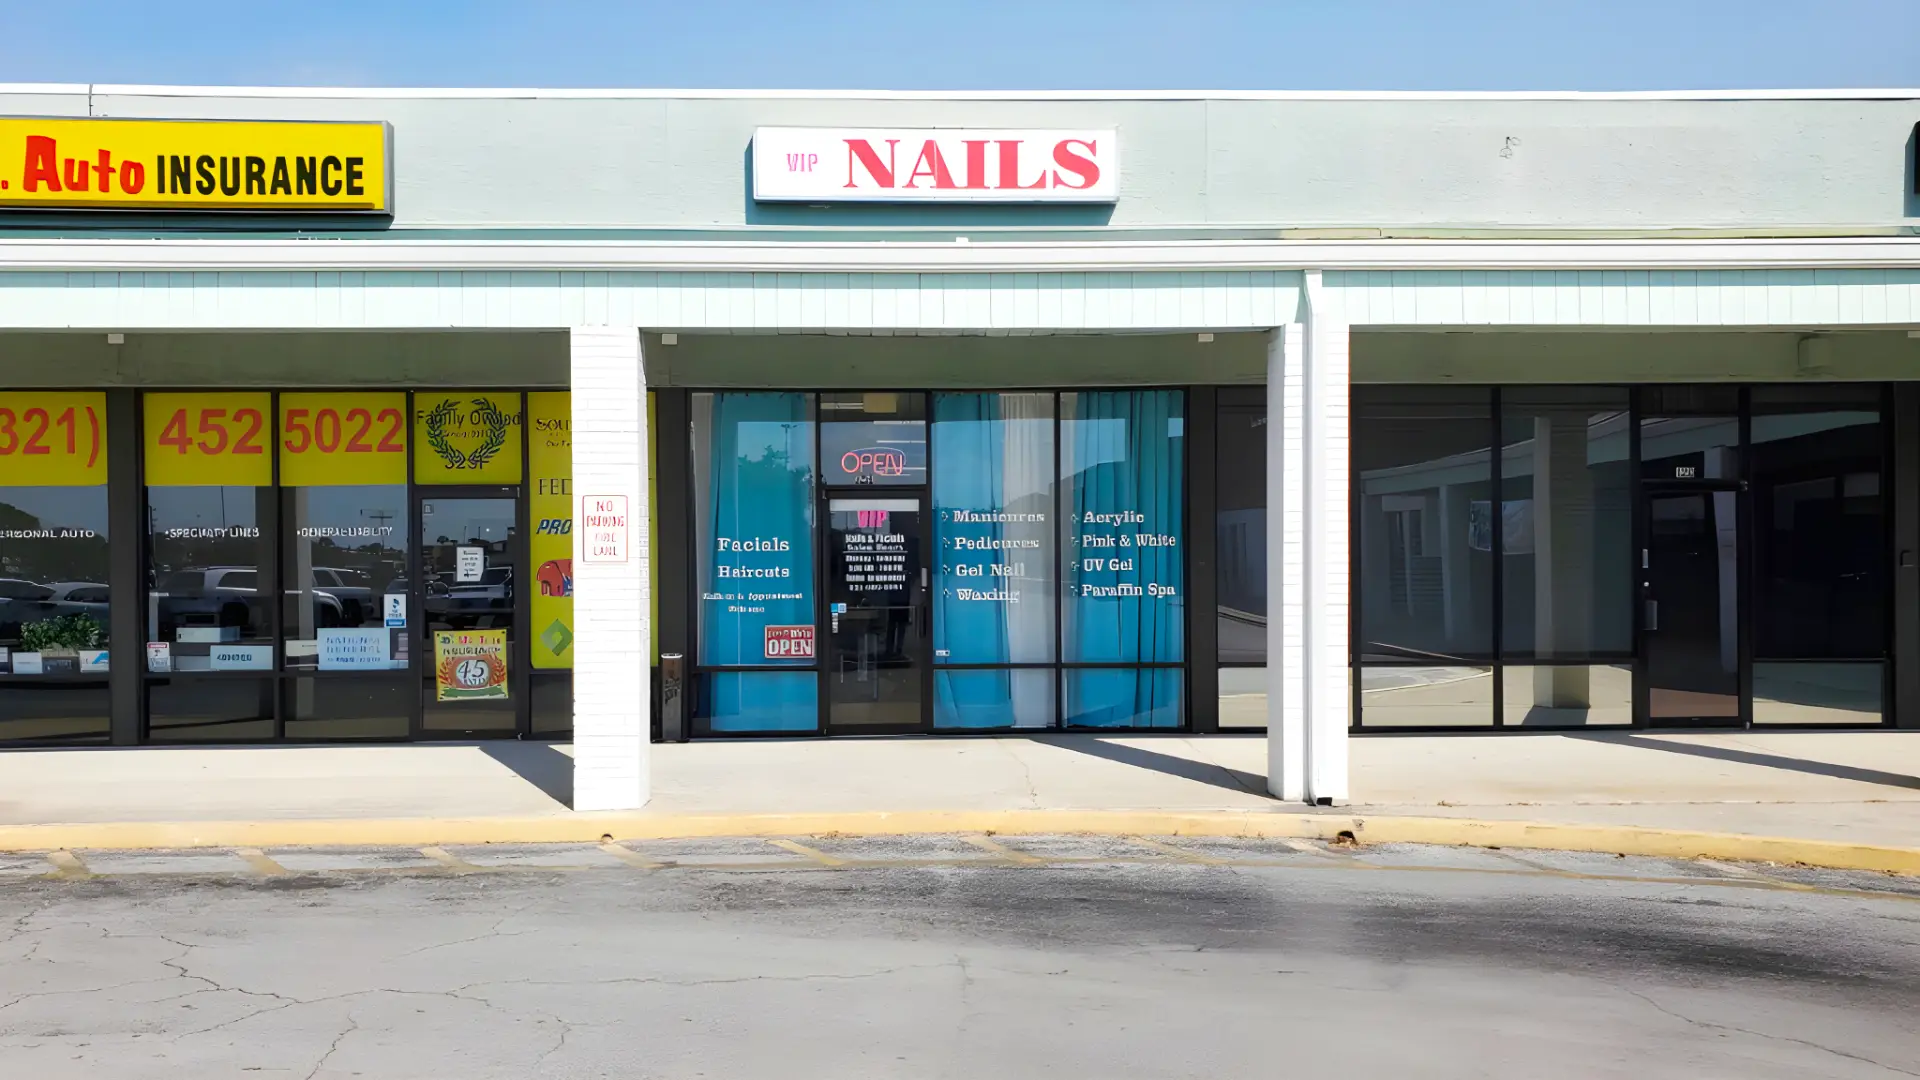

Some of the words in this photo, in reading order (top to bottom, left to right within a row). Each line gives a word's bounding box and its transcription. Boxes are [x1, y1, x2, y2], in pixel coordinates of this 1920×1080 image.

[23, 135, 145, 192] Auto
[157, 155, 364, 196] INSURANCE
[786, 153, 818, 172] VIP
[843, 139, 1101, 189] NAILS
[159, 408, 263, 455] 452
[285, 408, 404, 454] 5022
[841, 452, 903, 476] OPEN
[596, 500, 613, 511] NO
[857, 510, 887, 528] VIP
[953, 510, 1045, 522] Manicures
[1083, 510, 1144, 526] Acrylic
[60, 529, 95, 538] AUTO
[1082, 534, 1115, 547] Pink
[1119, 535, 1131, 547] &
[1136, 534, 1176, 547] White
[717, 537, 790, 551] Facials
[954, 537, 1040, 549] Pedicures
[717, 565, 790, 578] Haircuts
[955, 564, 983, 577] Gel
[990, 563, 1025, 577] Nail
[1083, 559, 1104, 571] UV
[1109, 558, 1133, 571] Gel
[1148, 583, 1176, 598] Spa
[768, 640, 812, 655] OPEN
[458, 659, 485, 679] 45
